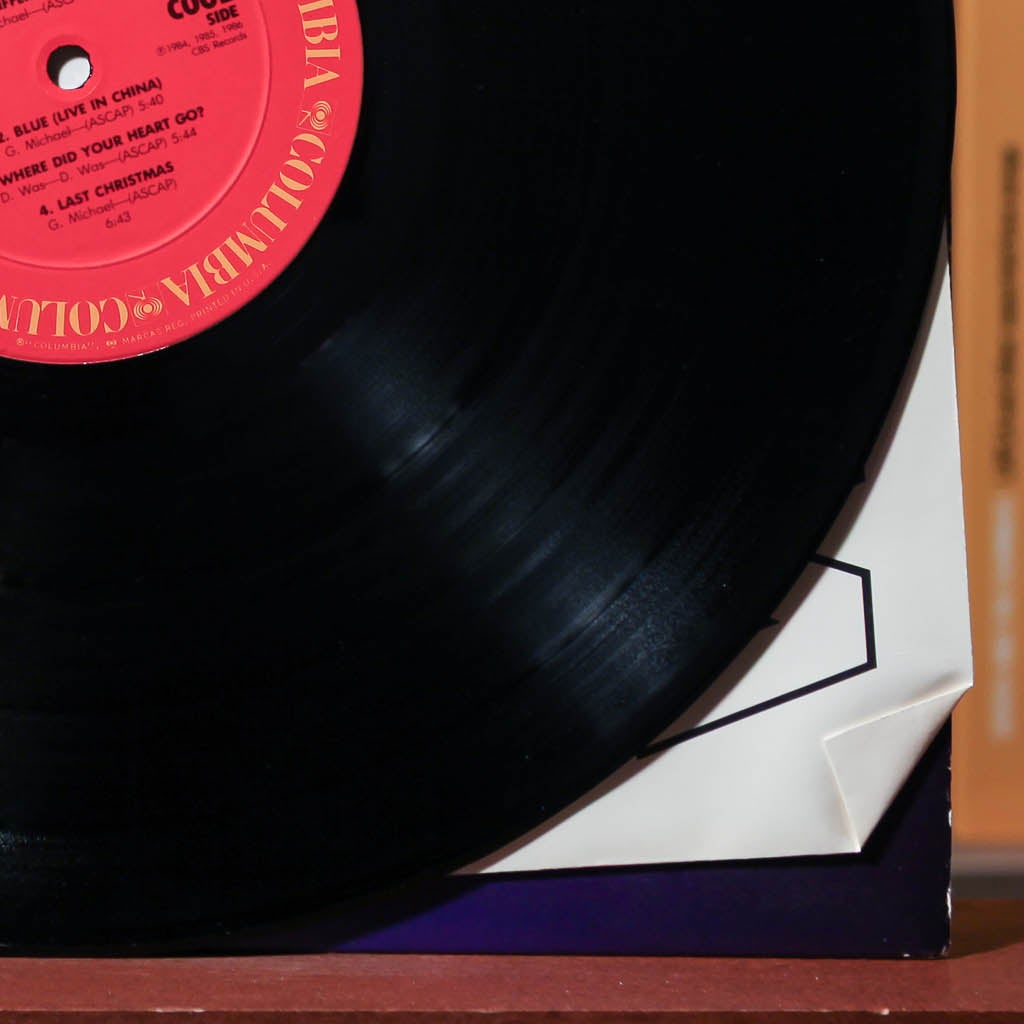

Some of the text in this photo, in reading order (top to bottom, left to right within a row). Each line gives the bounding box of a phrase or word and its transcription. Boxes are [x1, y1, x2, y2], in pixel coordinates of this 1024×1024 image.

[205, 5, 239, 26] SIDE
[191, 33, 248, 57] CBS Records
[4, 145, 21, 157] G.
[137, 93, 165, 112] 5:40
[13, 116, 50, 137] BLUE
[52, 102, 87, 126] (LIVE
[90, 96, 108, 111] IN
[111, 76, 163, 103] CHINA)
[0, 191, 15, 204] D.
[170, 126, 198, 145] 5:44
[52, 150, 78, 168] DID
[81, 134, 124, 158] YOUR
[127, 118, 171, 143] HEART
[175, 105, 205, 125] GO?
[39, 160, 175, 216] 4. LAST CHRISTMAS
[47, 218, 64, 231] G.
[105, 210, 132, 229] 6:43
[160, 133, 326, 306] COLUMBIA
